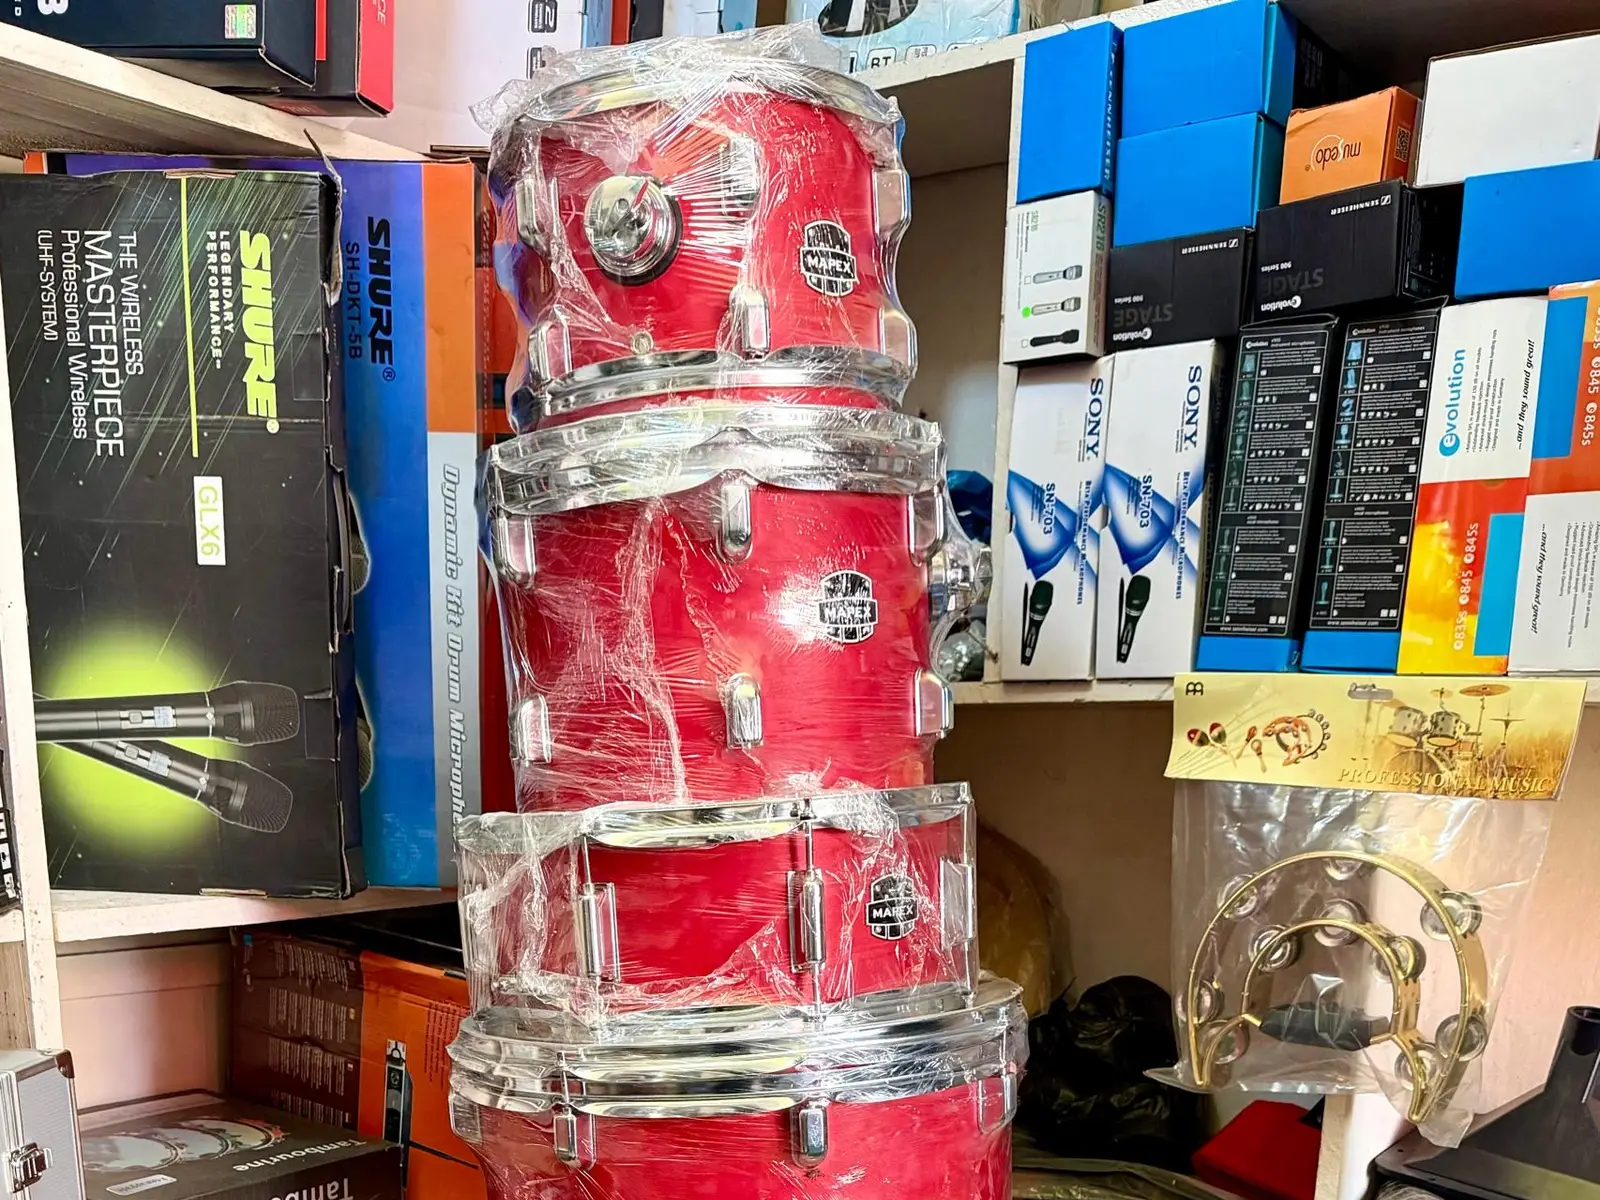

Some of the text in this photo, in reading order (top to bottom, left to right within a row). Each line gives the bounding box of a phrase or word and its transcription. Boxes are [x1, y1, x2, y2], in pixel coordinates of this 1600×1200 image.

[1315, 139, 1362, 171] musedo
[1331, 199, 1379, 215] SENNHEISER
[808, 255, 851, 274] MAPEX
[1182, 242, 1227, 254] SENNHEISER
[1261, 261, 1292, 272] 900 Series
[37, 229, 59, 342] (UHF-SYSTEM)
[119, 231, 144, 376] THE WIRELESS
[205, 230, 221, 361] PERFORMANCE
[219, 230, 234, 334] LEGENDARY
[345, 241, 363, 360] SH-DKT-5B
[367, 216, 395, 367] SHURE
[1261, 268, 1324, 296] STAGE
[60, 229, 88, 440] Professional Wireless
[239, 229, 278, 419] SHURE
[1114, 304, 1173, 327] STAGE
[84, 229, 125, 458] MASTERPIECE
[1525, 339, 1534, 368] great!
[1180, 364, 1202, 448] SONY
[1439, 349, 1466, 456] evolution
[1522, 370, 1531, 399] sound
[1087, 377, 1104, 459] SONY
[1519, 402, 1528, 422] they
[1084, 481, 1092, 498] BETA
[1139, 475, 1152, 528] SN-703
[1182, 471, 1190, 490] BETA
[198, 486, 220, 557] GLX6
[442, 463, 461, 580] Dynamic
[1043, 483, 1055, 534] SN-703
[1080, 500, 1090, 551] PERFORMANCE
[1179, 492, 1189, 544] PERFORMANCE
[1077, 554, 1087, 605] MICROPHONES
[1176, 547, 1185, 599] MICROPHONES
[1536, 553, 1545, 574] they
[447, 585, 464, 628] Kit
[824, 602, 873, 621] MAPEX
[1534, 575, 1542, 605] sound
[1531, 605, 1539, 634] great!
[448, 632, 462, 702] Drum
[1338, 769, 1548, 793] PROFESSIONAL MUSIC
[872, 903, 914, 919] MAPEX
[232, 1138, 366, 1174] Tambourine
